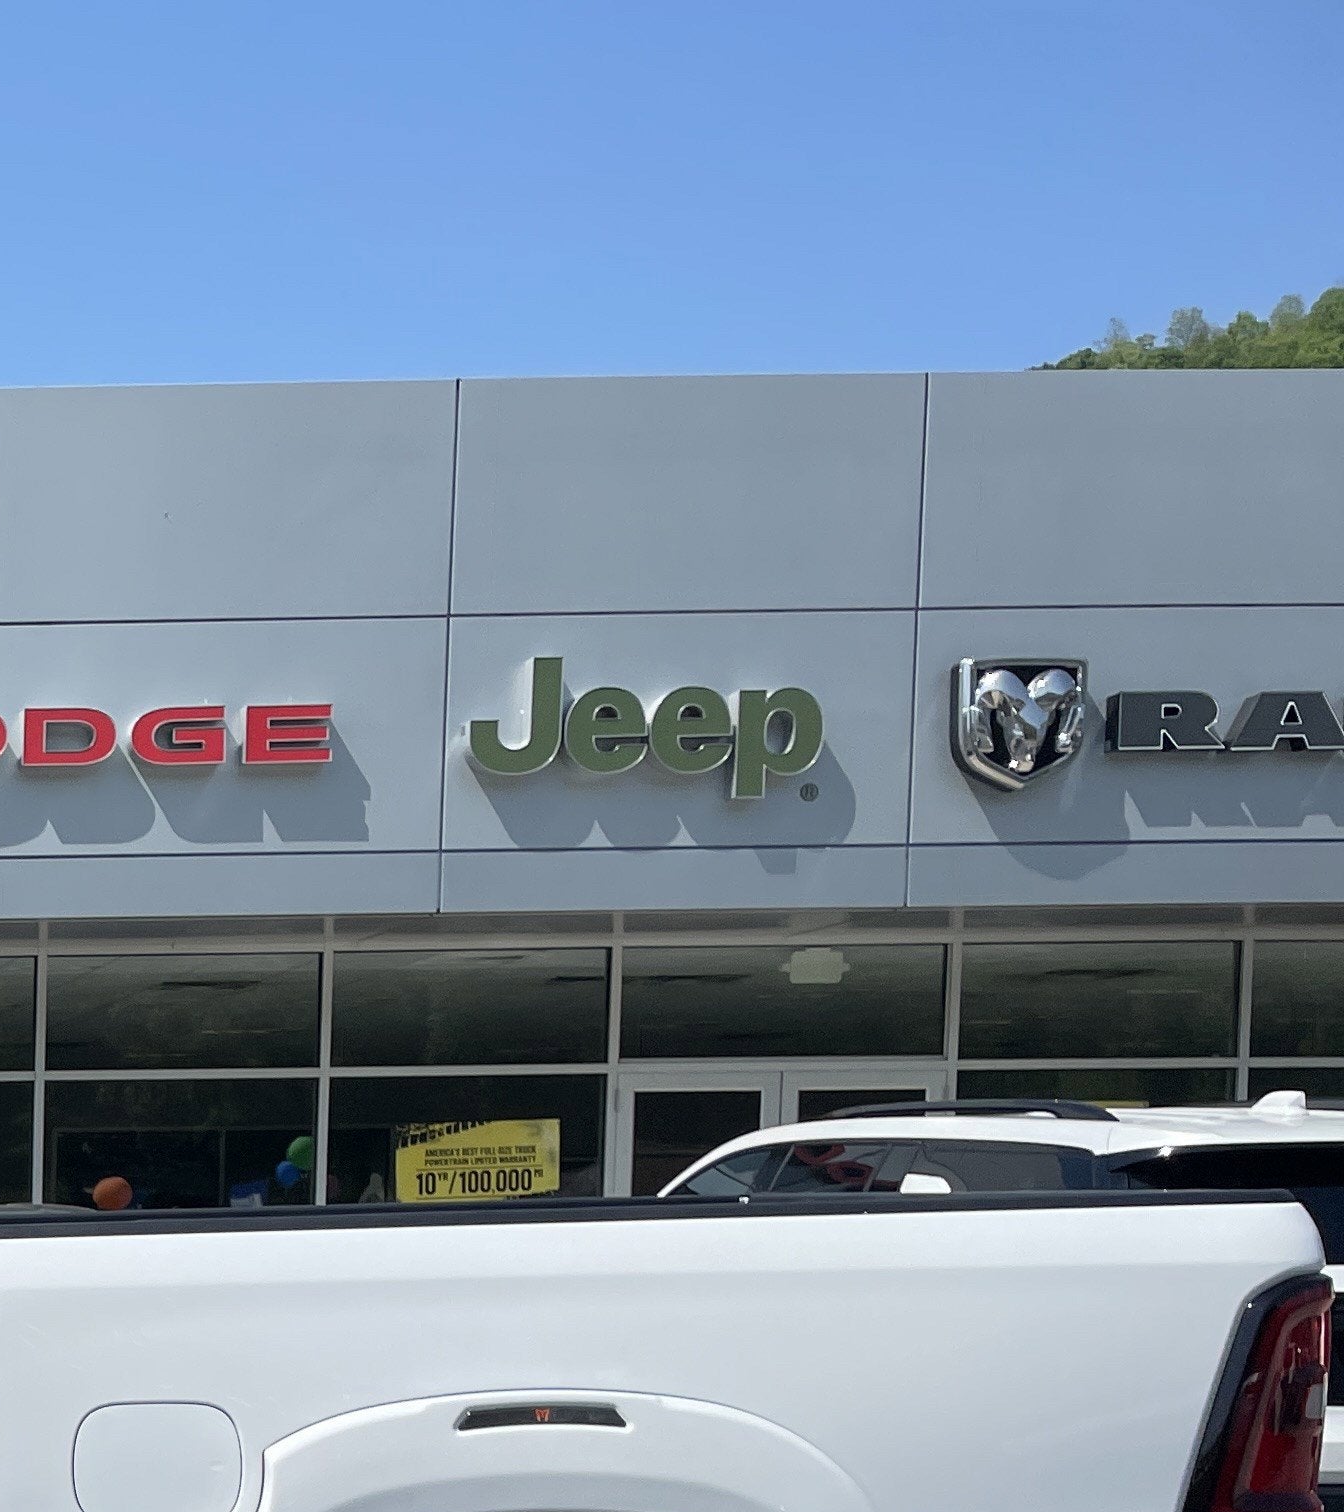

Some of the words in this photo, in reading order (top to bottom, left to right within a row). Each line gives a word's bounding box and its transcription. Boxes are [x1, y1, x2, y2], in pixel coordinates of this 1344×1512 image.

[468, 656, 825, 799] Jeep
[1116, 690, 1344, 751] RA
[499, 1155, 536, 1164] WARRANTY
